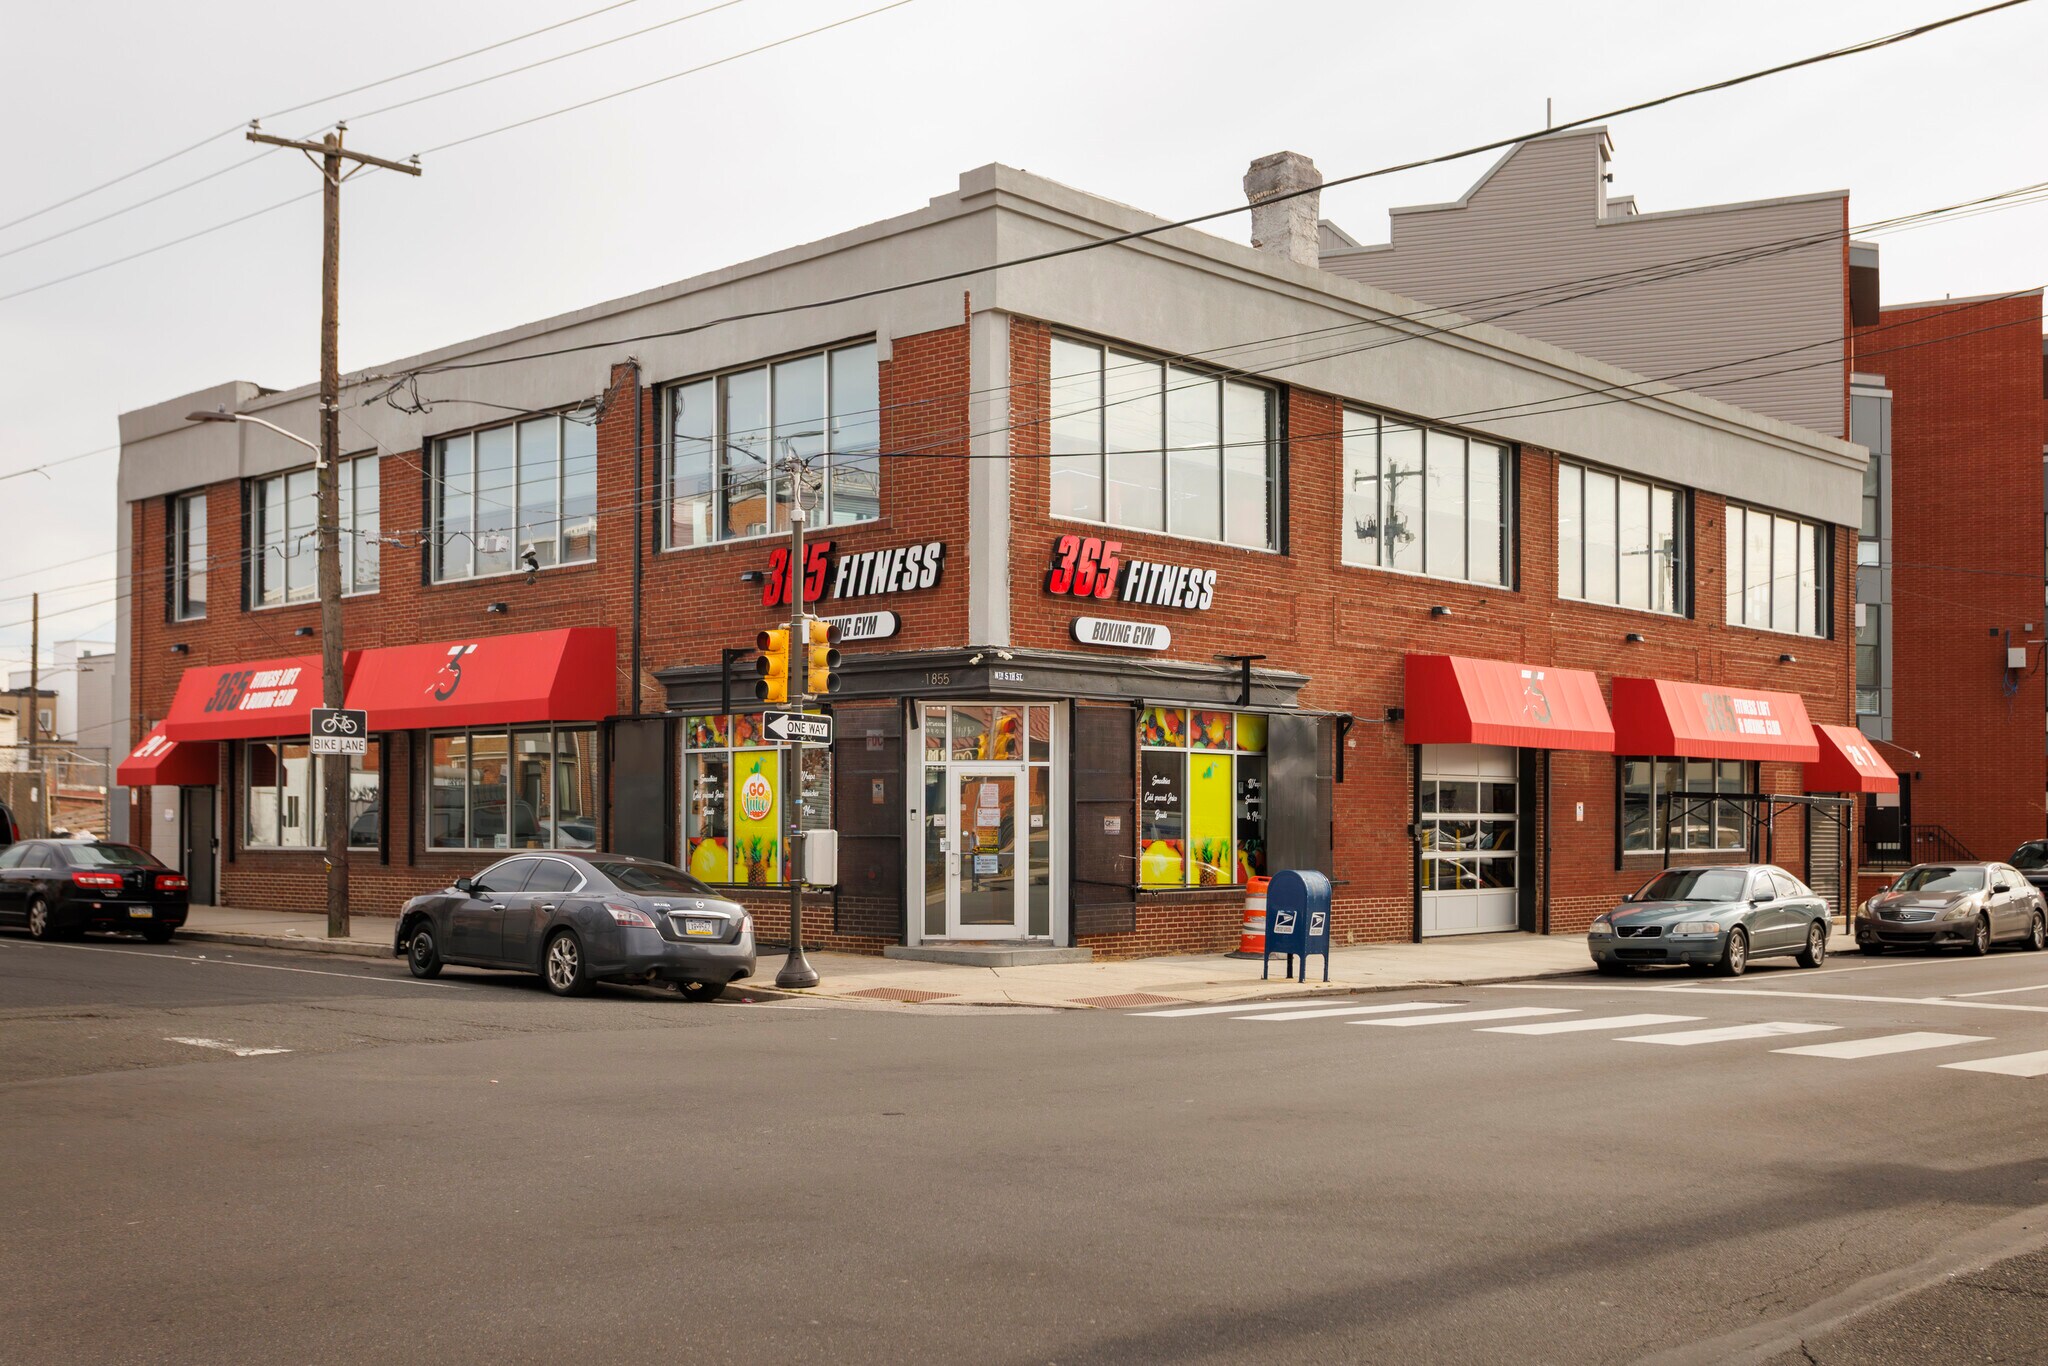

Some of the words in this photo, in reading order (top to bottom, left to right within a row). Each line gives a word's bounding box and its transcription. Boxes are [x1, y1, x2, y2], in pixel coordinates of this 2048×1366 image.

[833, 542, 941, 599] FITNESS
[1050, 535, 1122, 599] 365
[1123, 560, 1217, 610] FITNESS
[853, 615, 878, 636] GYM
[1092, 621, 1131, 644] BOXING
[1132, 626, 1156, 646] GYM
[925, 672, 950, 685] 1855
[205, 670, 254, 713] 365
[787, 721, 806, 734] ONE
[808, 723, 826, 735] WAY
[314, 739, 337, 750] BIKE
[340, 740, 364, 751] LANE
[749, 782, 765, 797] GO
